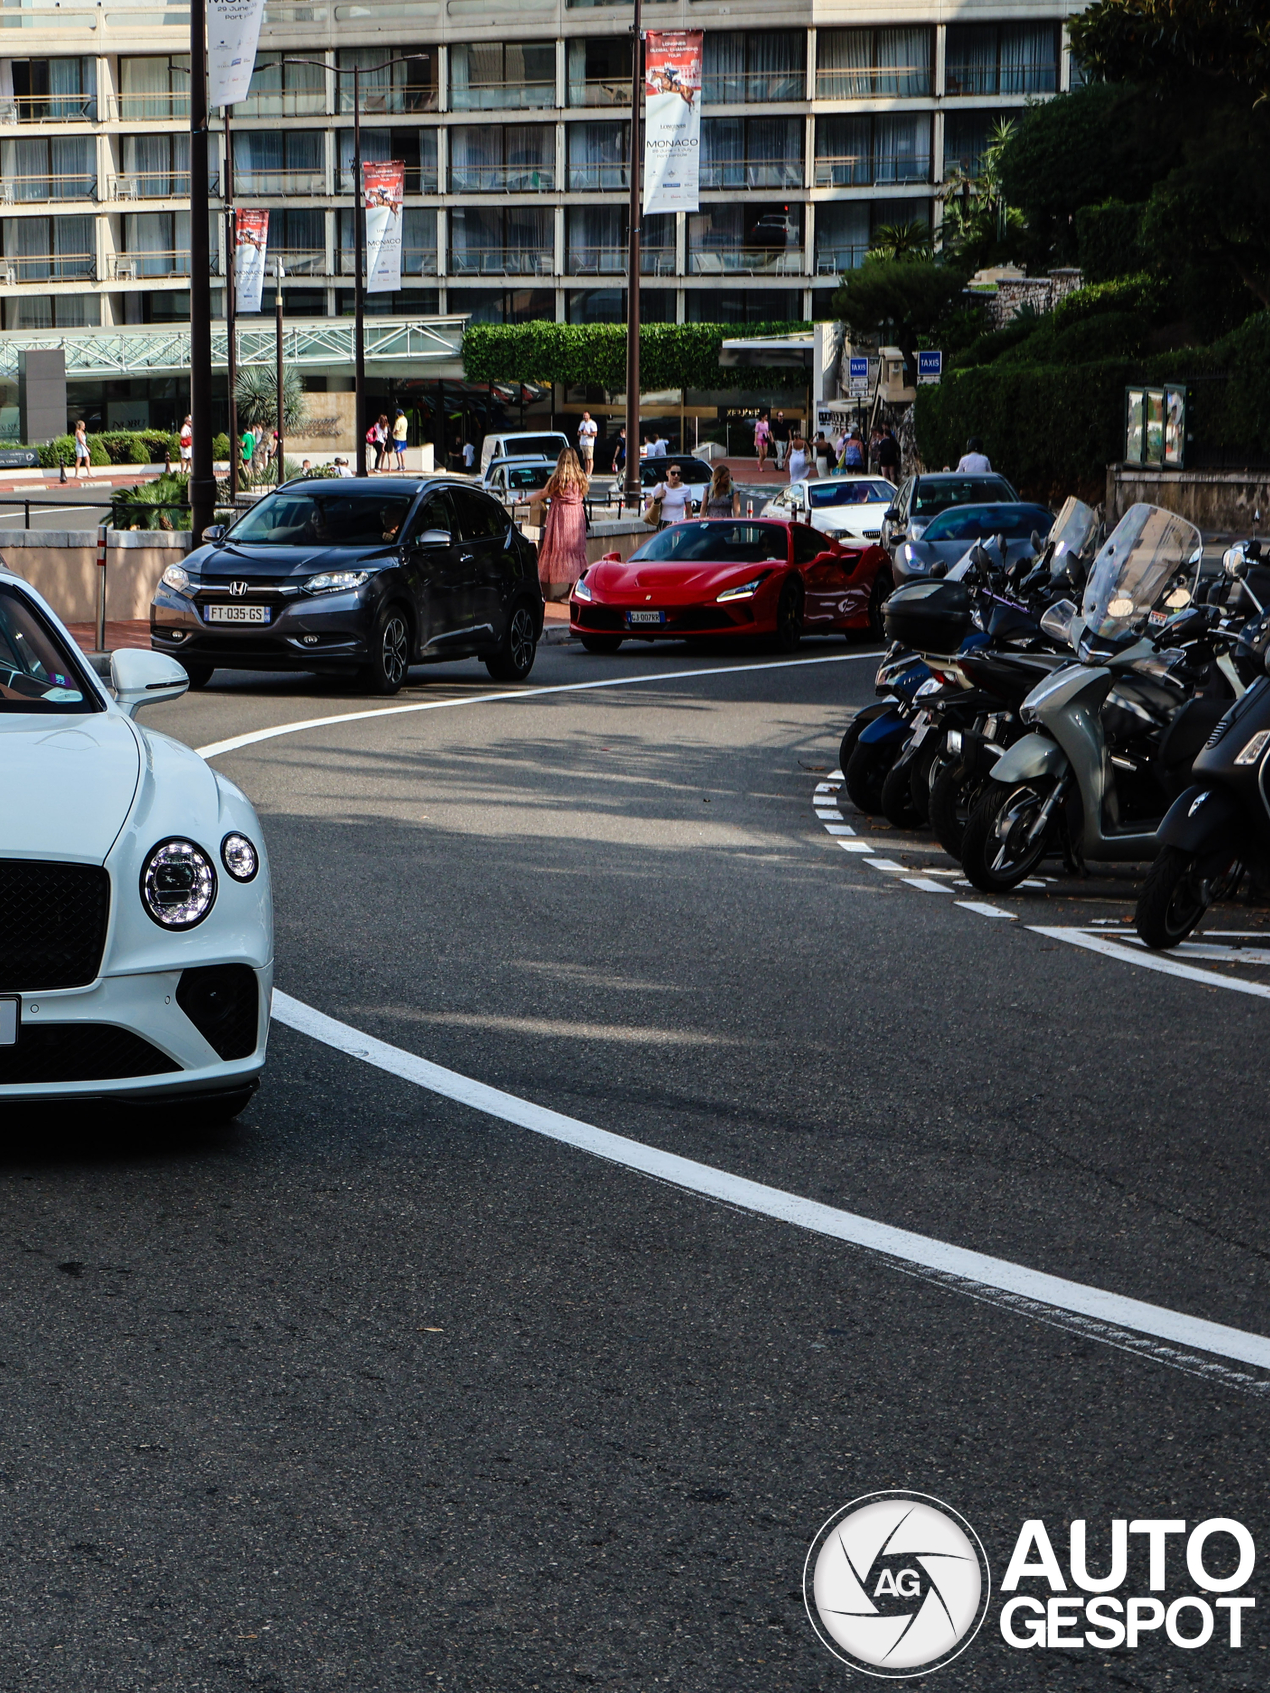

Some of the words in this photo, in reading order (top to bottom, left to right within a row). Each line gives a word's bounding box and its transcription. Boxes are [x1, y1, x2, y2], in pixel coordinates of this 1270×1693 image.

[646, 138, 699, 149] MONACO
[368, 238, 401, 247] MONACO
[920, 359, 940, 367] TAXIS
[112, 419, 146, 429] NOBU
